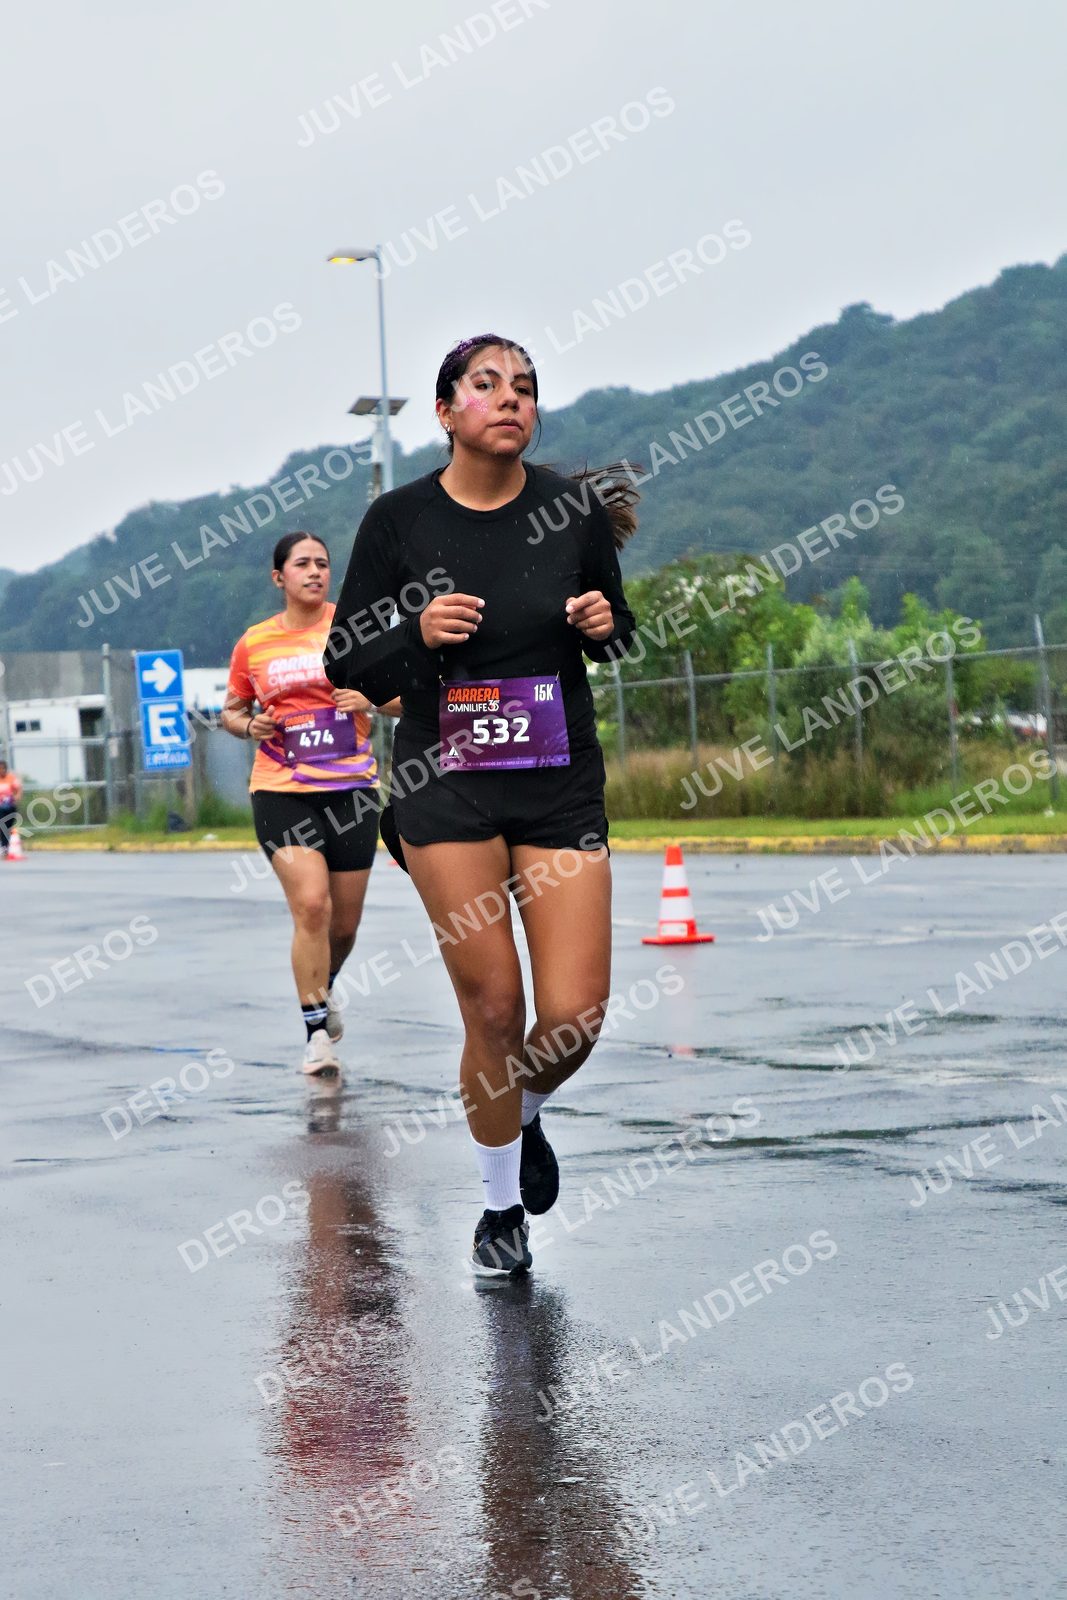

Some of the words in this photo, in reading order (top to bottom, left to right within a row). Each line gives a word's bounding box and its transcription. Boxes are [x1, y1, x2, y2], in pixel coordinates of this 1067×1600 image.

[447, 688, 500, 702] CARRERA
[534, 684, 554, 702] 15K
[148, 703, 181, 745] E
[473, 717, 530, 744] 532
[299, 729, 334, 747] 474
